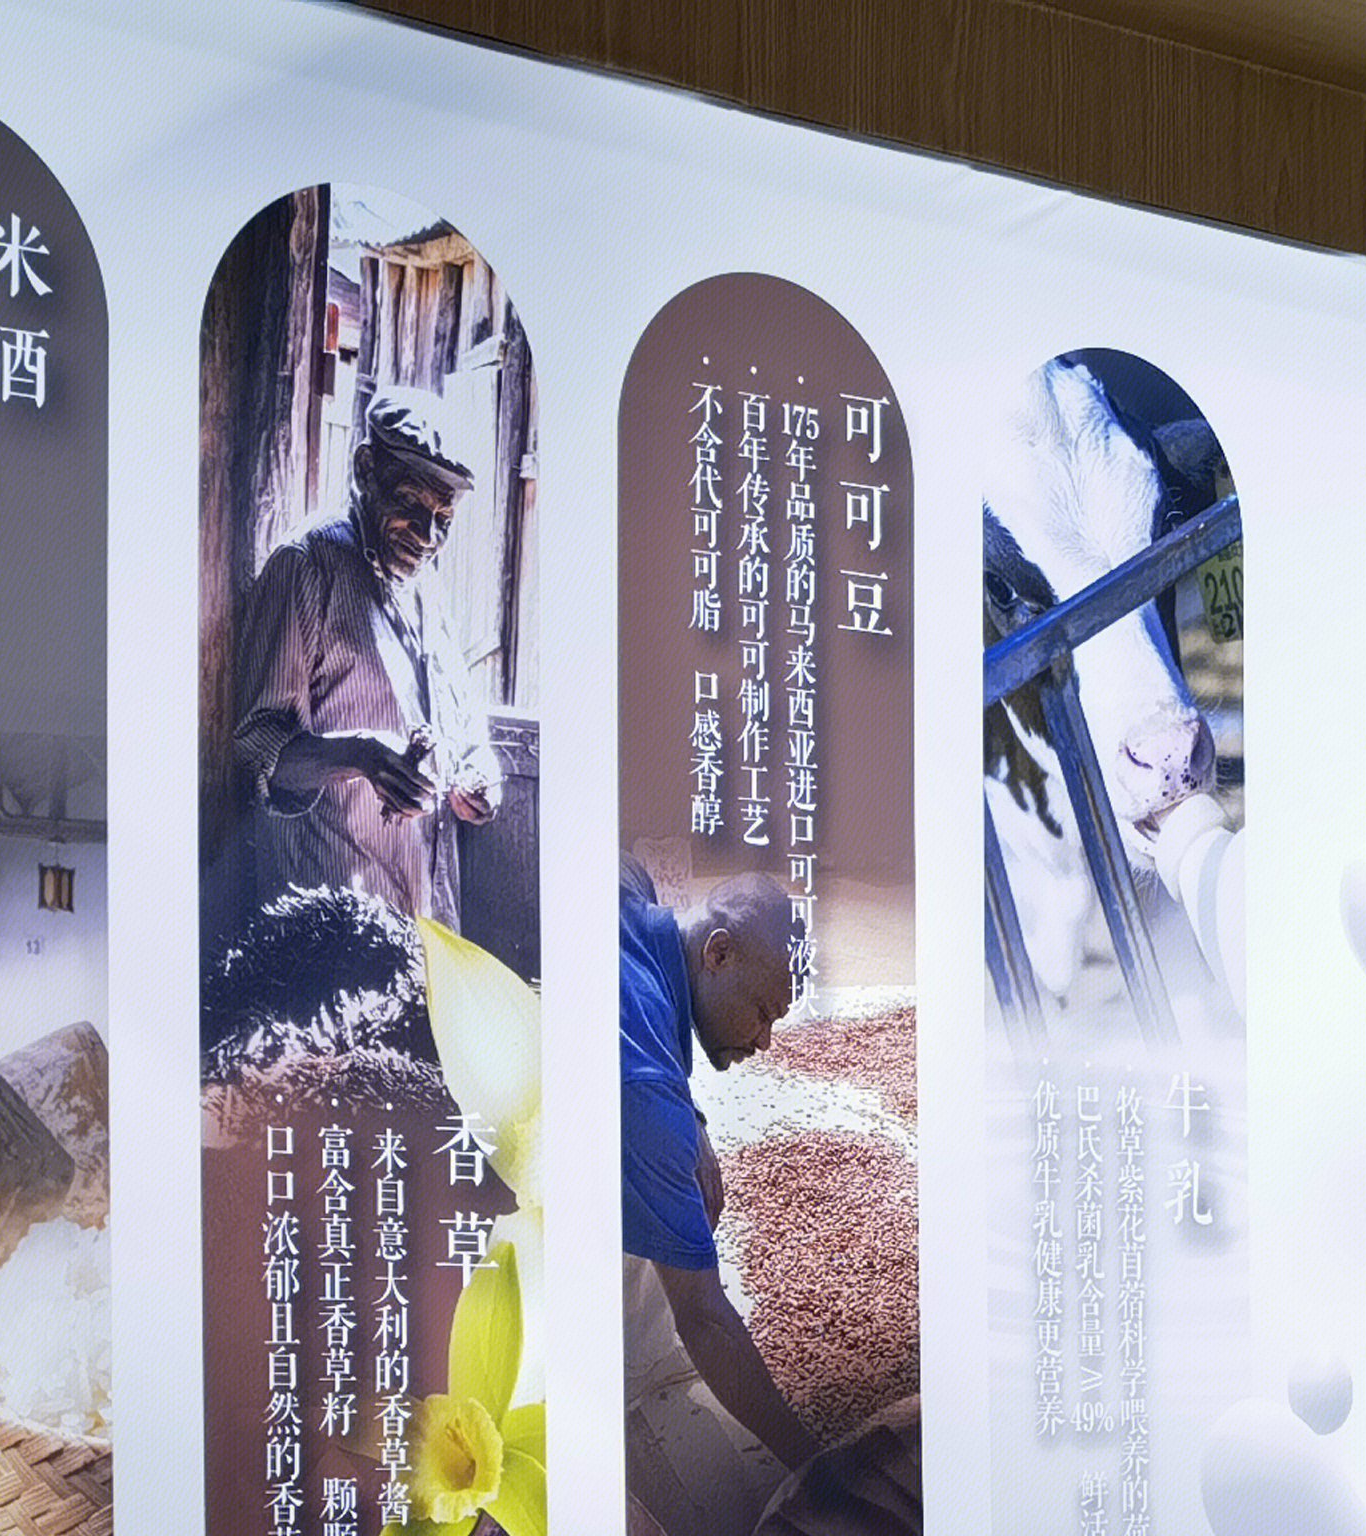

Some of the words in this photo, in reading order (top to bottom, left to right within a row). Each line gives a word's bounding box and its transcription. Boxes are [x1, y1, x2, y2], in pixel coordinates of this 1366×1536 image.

[688, 382, 723, 632] 不含代可可脂
[736, 391, 771, 846] 百年传承的可可制作工艺
[838, 393, 893, 636] 可可豆
[688, 670, 724, 836] 口感香醇
[782, 402, 820, 1016] 175年品质的马来西亚进口可可液块
[317, 1124, 357, 1438] 富含真正香草籽
[433, 1111, 499, 1288] 香草
[1032, 1080, 1063, 1436] 优质牛乳健康更营养
[1163, 1071, 1213, 1226] 牛乳
[371, 1128, 413, 1527] 来自意大利的香草酱
